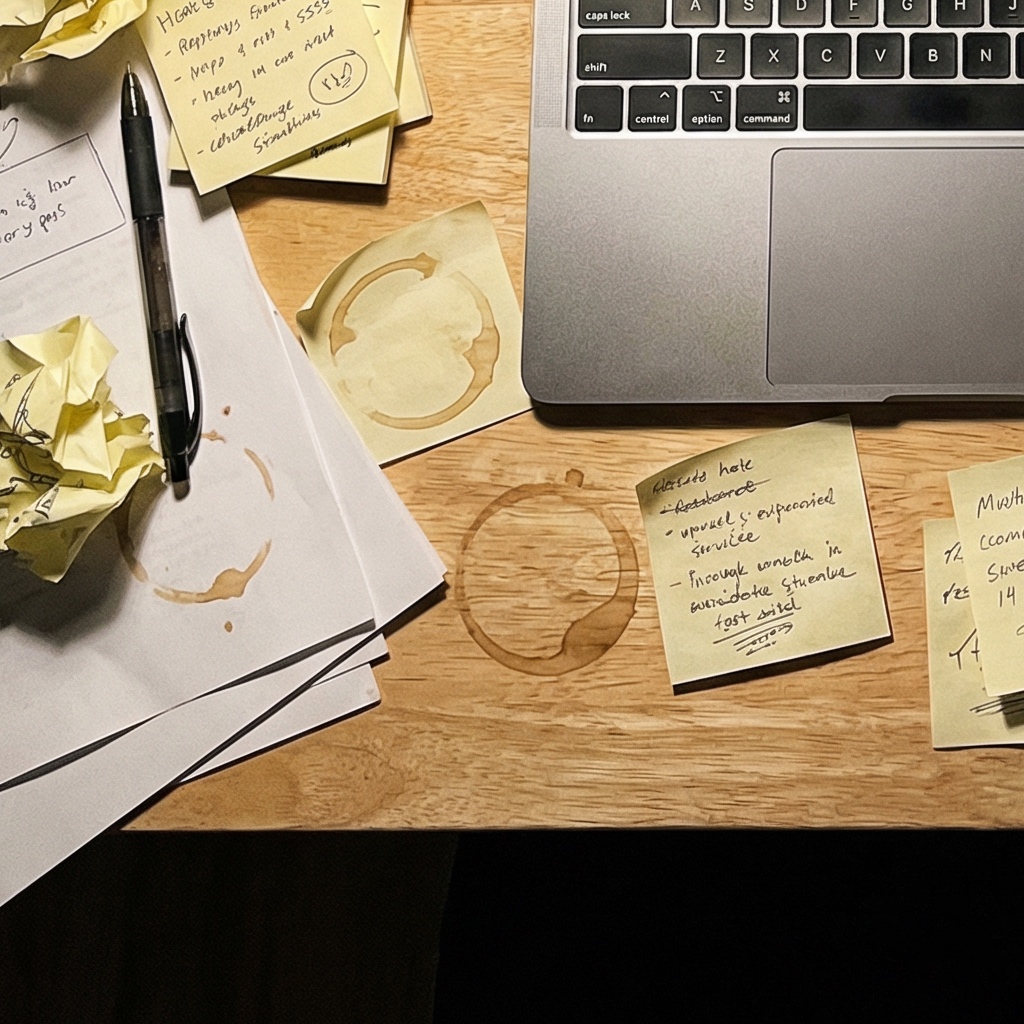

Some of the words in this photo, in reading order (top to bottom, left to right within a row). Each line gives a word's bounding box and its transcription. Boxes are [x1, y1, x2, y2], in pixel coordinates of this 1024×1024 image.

[716, 50, 725, 62] Z
[769, 50, 779, 62] X
[822, 49, 831, 62] C
[875, 49, 886, 61] V
[929, 49, 938, 61] B
[981, 49, 991, 61] N
